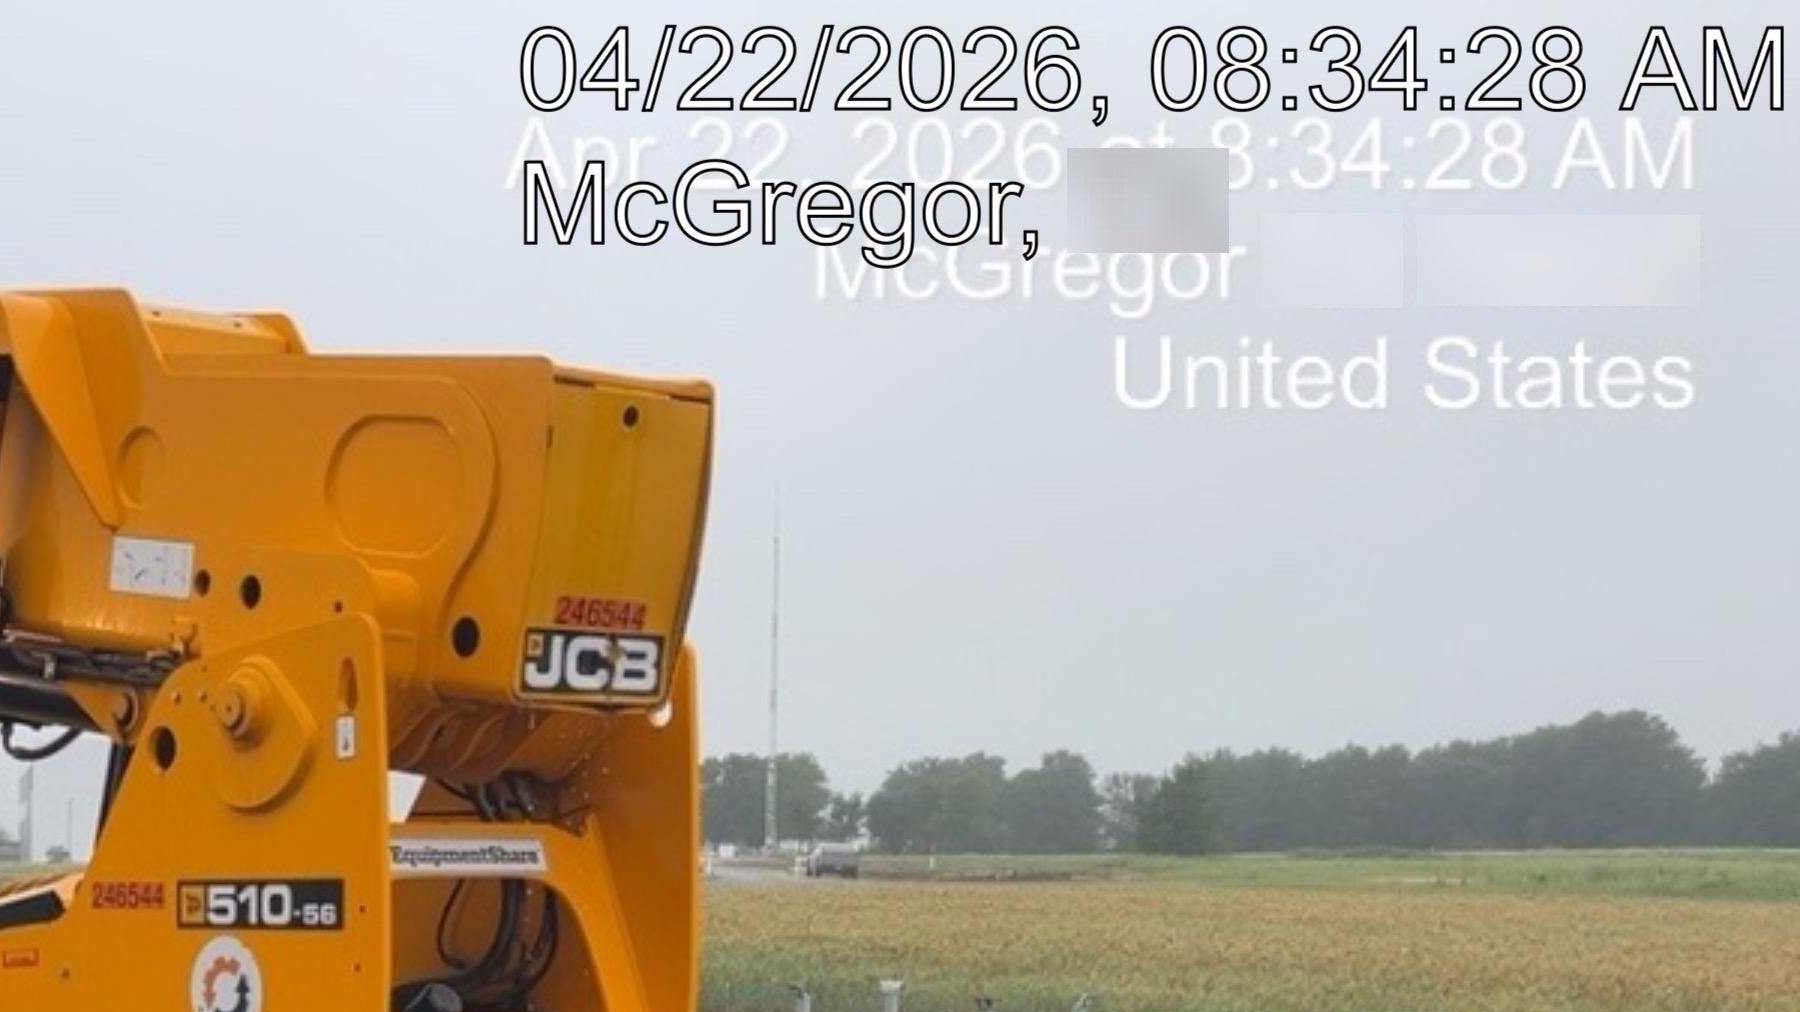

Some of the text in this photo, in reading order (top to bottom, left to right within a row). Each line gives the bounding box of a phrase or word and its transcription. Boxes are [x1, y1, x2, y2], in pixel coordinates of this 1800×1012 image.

[554, 596, 647, 630] 246544
[524, 633, 659, 692] JCB
[91, 881, 164, 909] 246544
